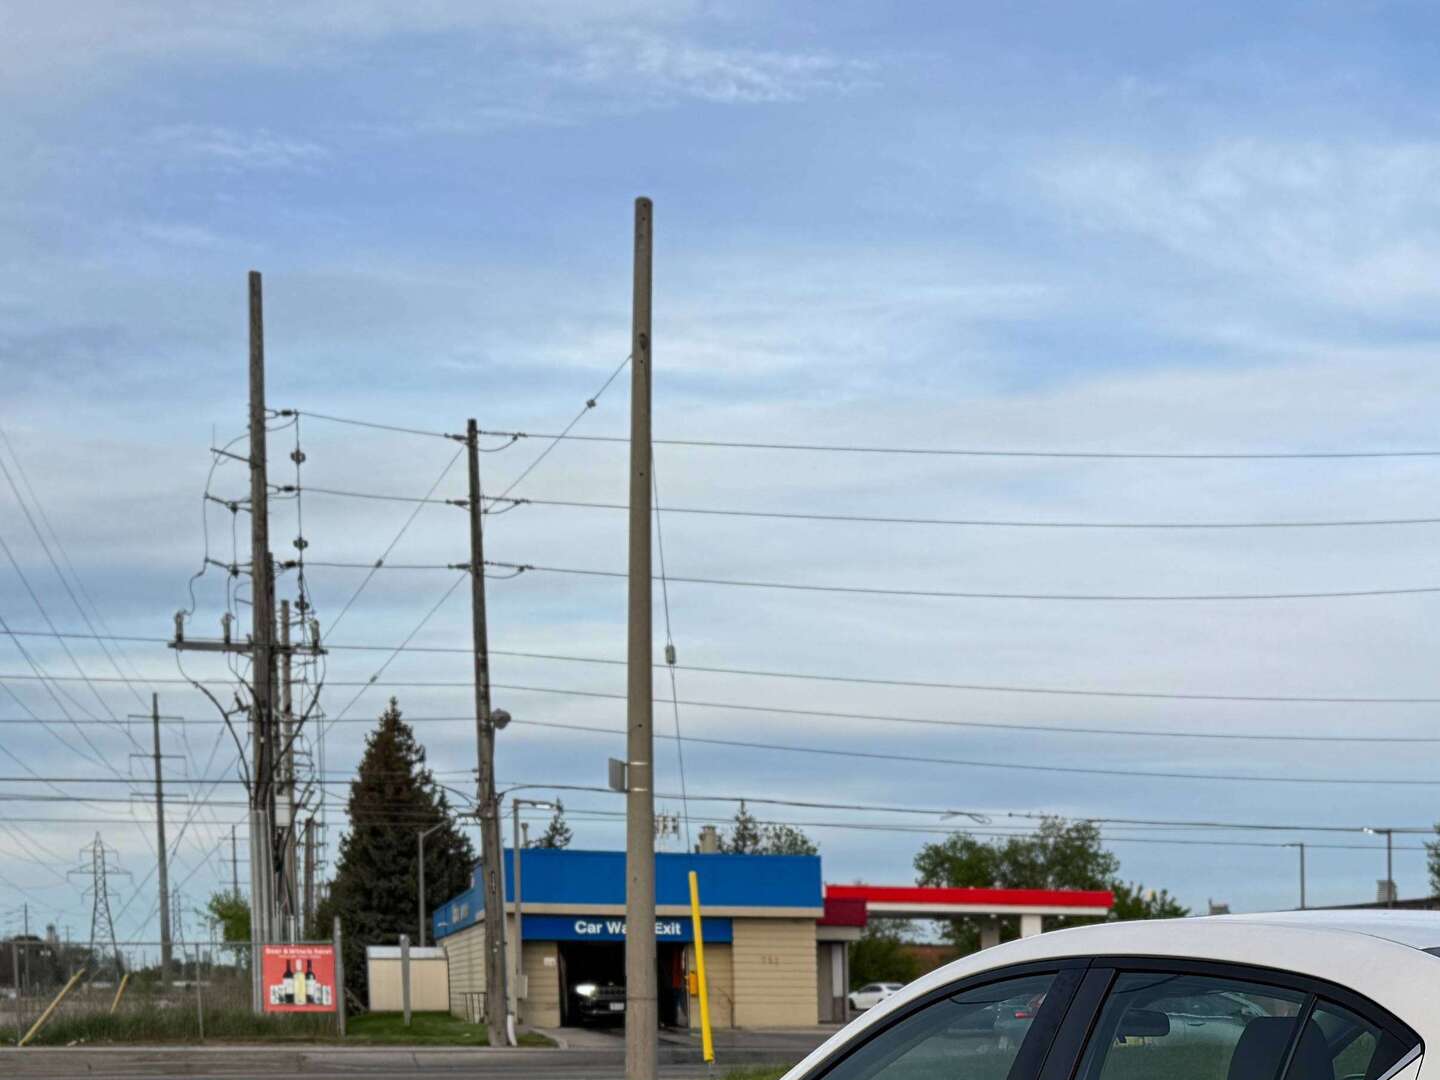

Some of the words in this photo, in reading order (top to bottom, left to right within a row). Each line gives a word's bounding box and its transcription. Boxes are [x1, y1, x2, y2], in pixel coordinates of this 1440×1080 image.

[574, 920, 602, 934] Car
[606, 921, 627, 934] Wa
[655, 922, 681, 935] Exit
